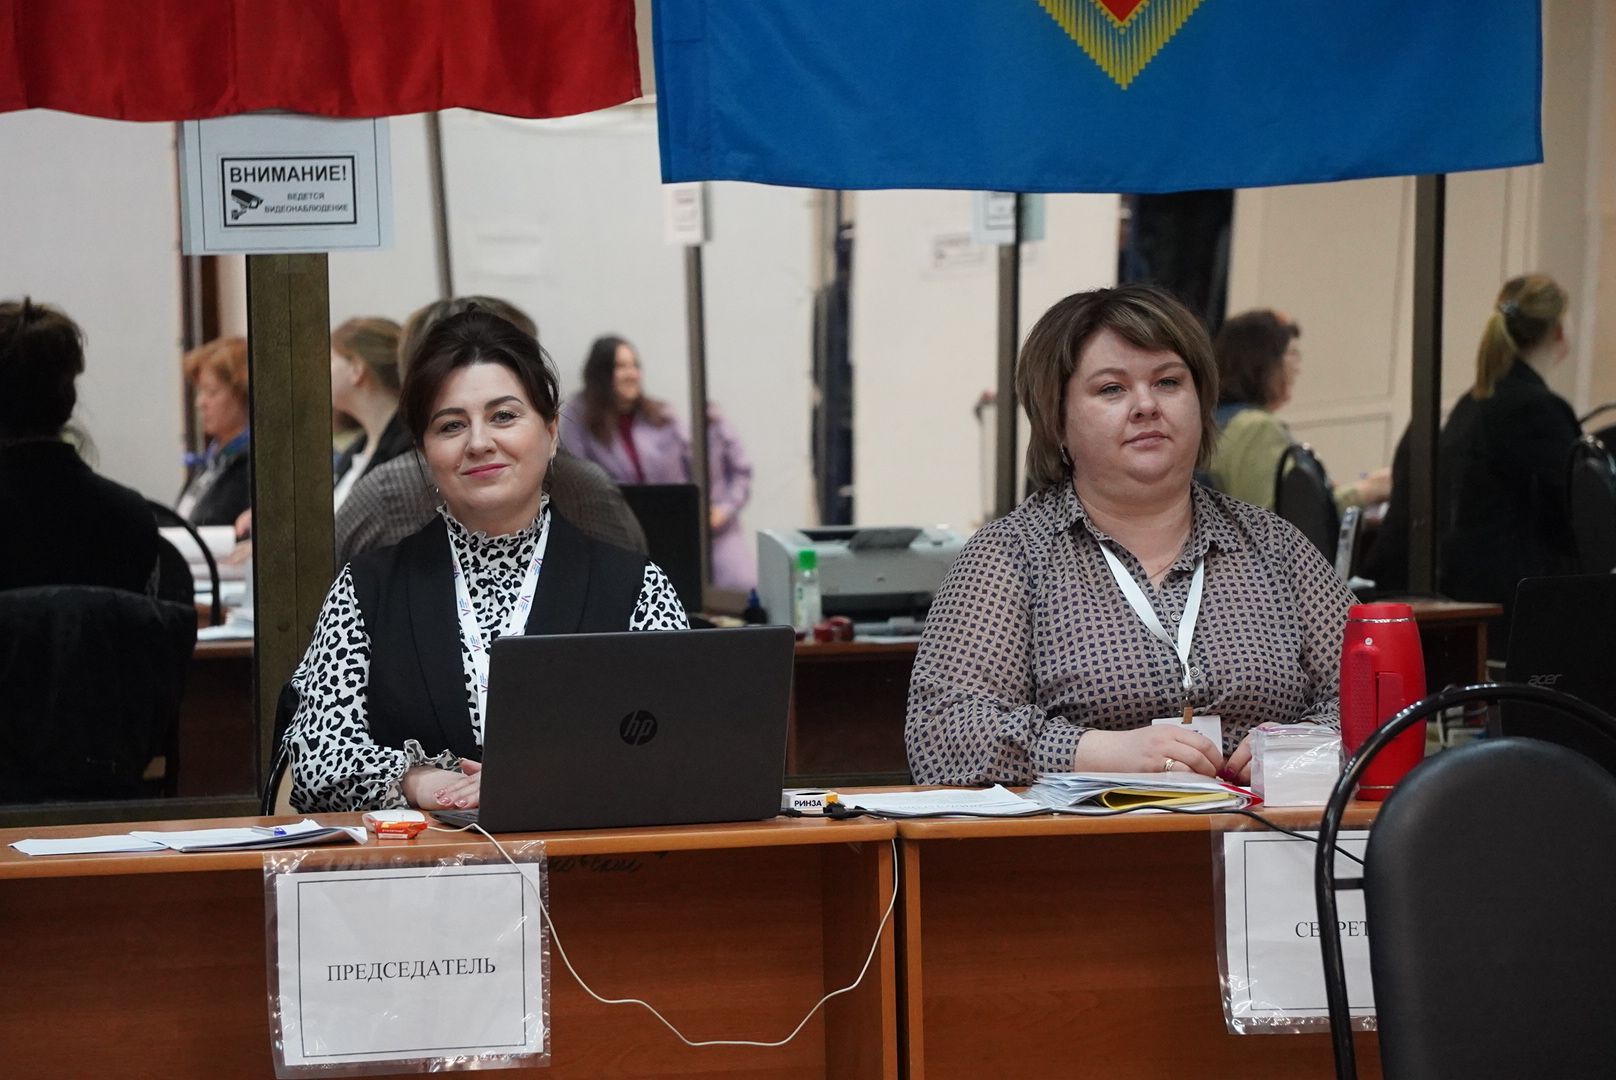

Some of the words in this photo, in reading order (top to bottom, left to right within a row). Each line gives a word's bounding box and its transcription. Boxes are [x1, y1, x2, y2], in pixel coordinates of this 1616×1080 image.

[229, 165, 347, 184] ВНИМАНИЕ!
[287, 191, 325, 201] ВЕДЕТСЯ
[264, 203, 348, 214] ВИДЕОНАБЛЮДЕНИЕ
[1527, 673, 1563, 685] acer
[622, 710, 656, 746] hp
[794, 799, 822, 807] РИНЗА
[327, 957, 497, 983] ПРЕДСЕДАТЕЛЬ
